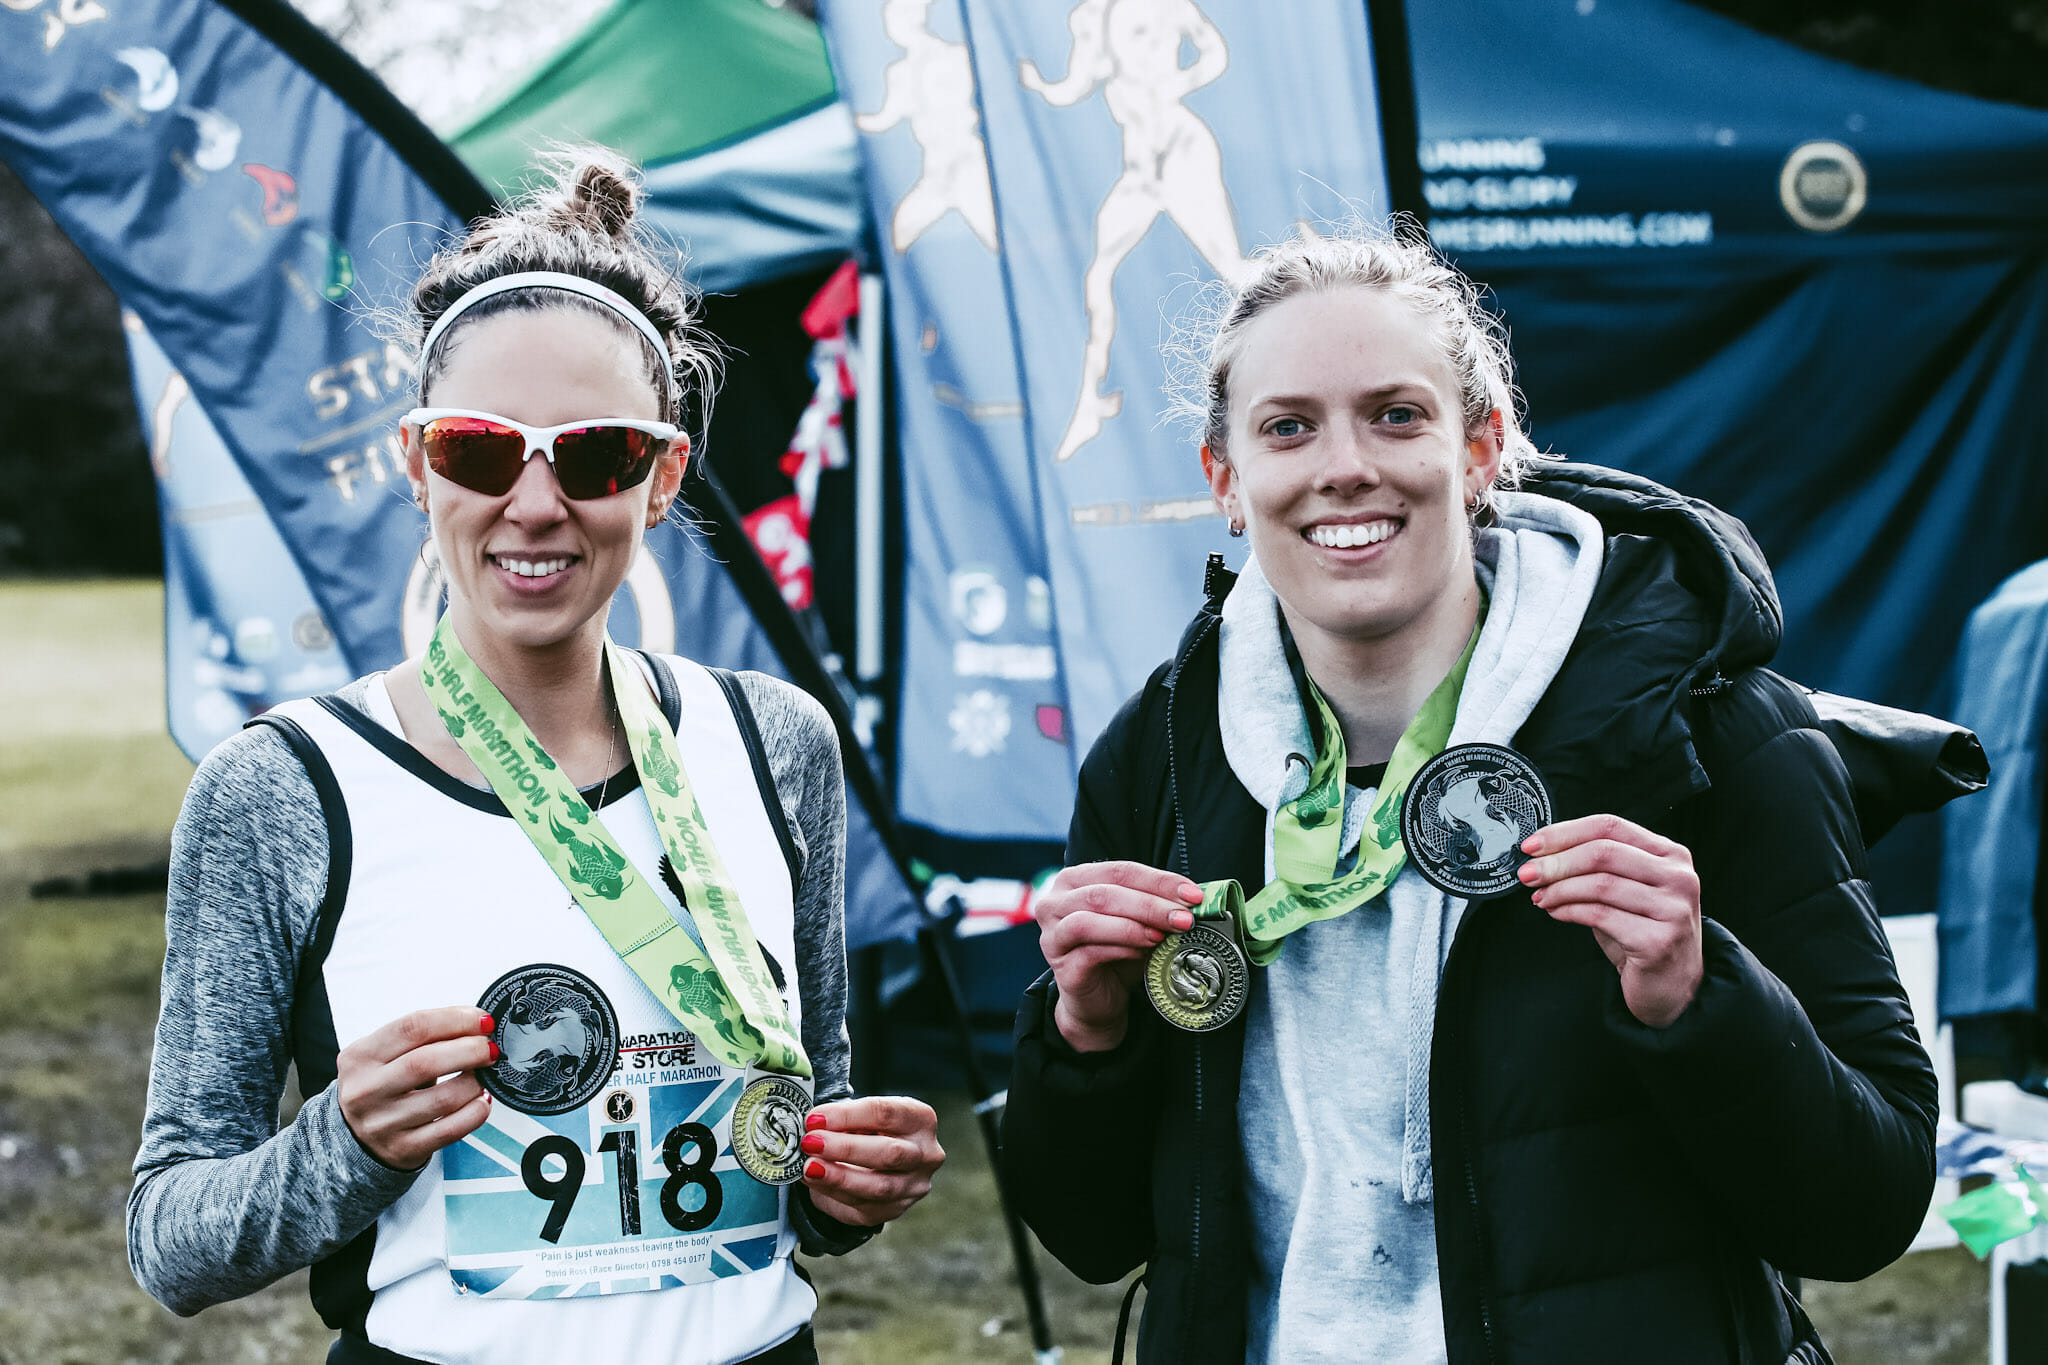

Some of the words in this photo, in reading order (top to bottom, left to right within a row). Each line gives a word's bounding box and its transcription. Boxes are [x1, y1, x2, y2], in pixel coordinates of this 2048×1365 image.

[437, 660, 475, 706] HALF
[463, 703, 551, 808] MARATHON
[632, 1047, 696, 1069] STORE
[626, 1071, 656, 1086] HALF
[660, 1065, 721, 1082] MARATHON
[521, 1122, 723, 1245] 918
[565, 1249, 573, 1260] is
[575, 1248, 593, 1261] just
[595, 1245, 640, 1257] weakness
[642, 1241, 673, 1253] leaving
[675, 1238, 689, 1249] the
[545, 1268, 567, 1278] David
[651, 1258, 671, 1269] 0798
[673, 1256, 687, 1266] 454
[688, 1253, 706, 1264] 0177
